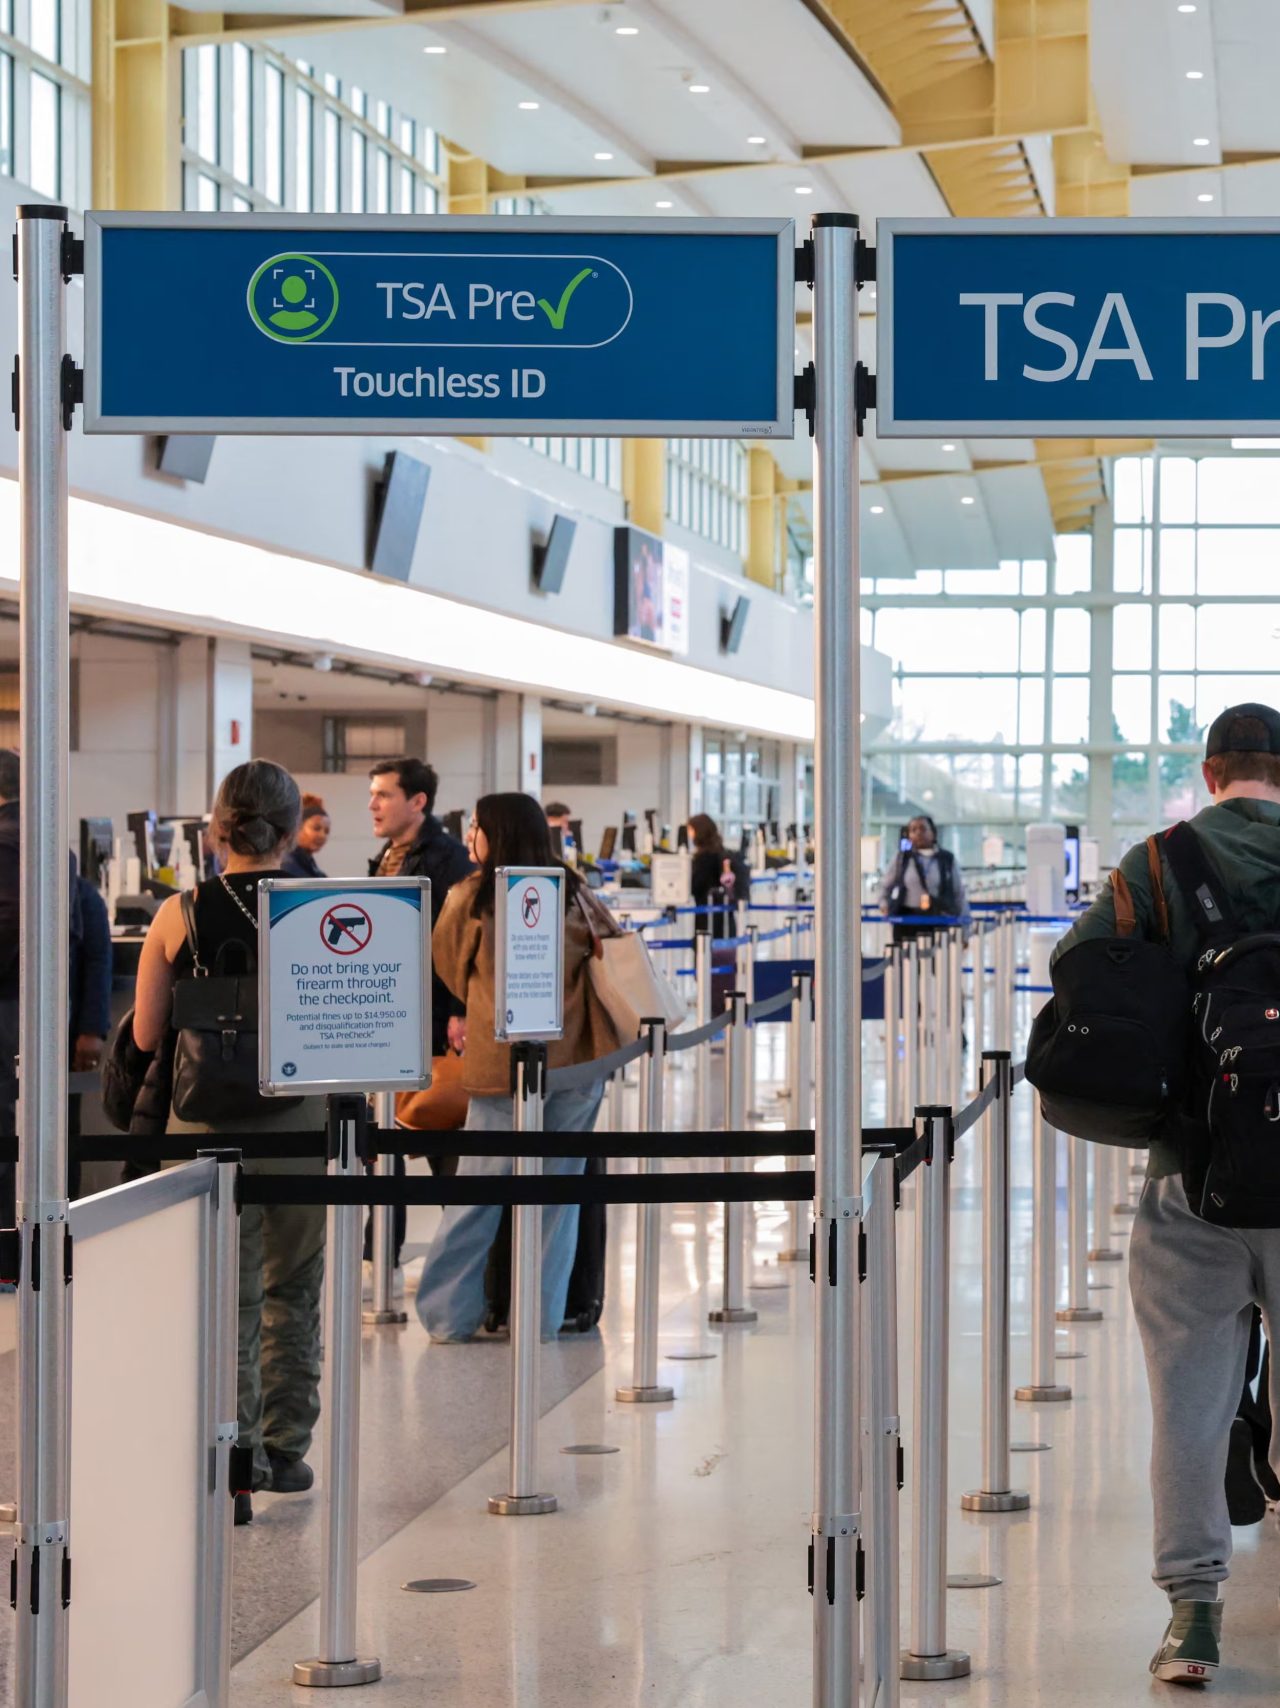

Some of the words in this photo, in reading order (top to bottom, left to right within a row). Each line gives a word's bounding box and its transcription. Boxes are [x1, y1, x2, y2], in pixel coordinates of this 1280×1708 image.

[376, 282, 456, 320] TSA
[958, 291, 1154, 382] TSA
[333, 365, 500, 399] Touchless
[510, 367, 546, 399] ID
[291, 964, 308, 975] Do
[312, 964, 332, 975] not
[336, 962, 369, 976] bring
[372, 962, 402, 976] your
[296, 978, 344, 990] firearm
[347, 976, 396, 990] through
[299, 994, 320, 1006] the
[322, 991, 394, 1006] checkpoint.
[286, 1012, 320, 1022] Potential
[322, 1012, 341, 1021] fines
[342, 1013, 352, 1022] up
[299, 1022, 314, 1030] and
[315, 1021, 374, 1032] disqualification
[376, 1020, 394, 1028] from
[320, 1032, 334, 1040] TSA
